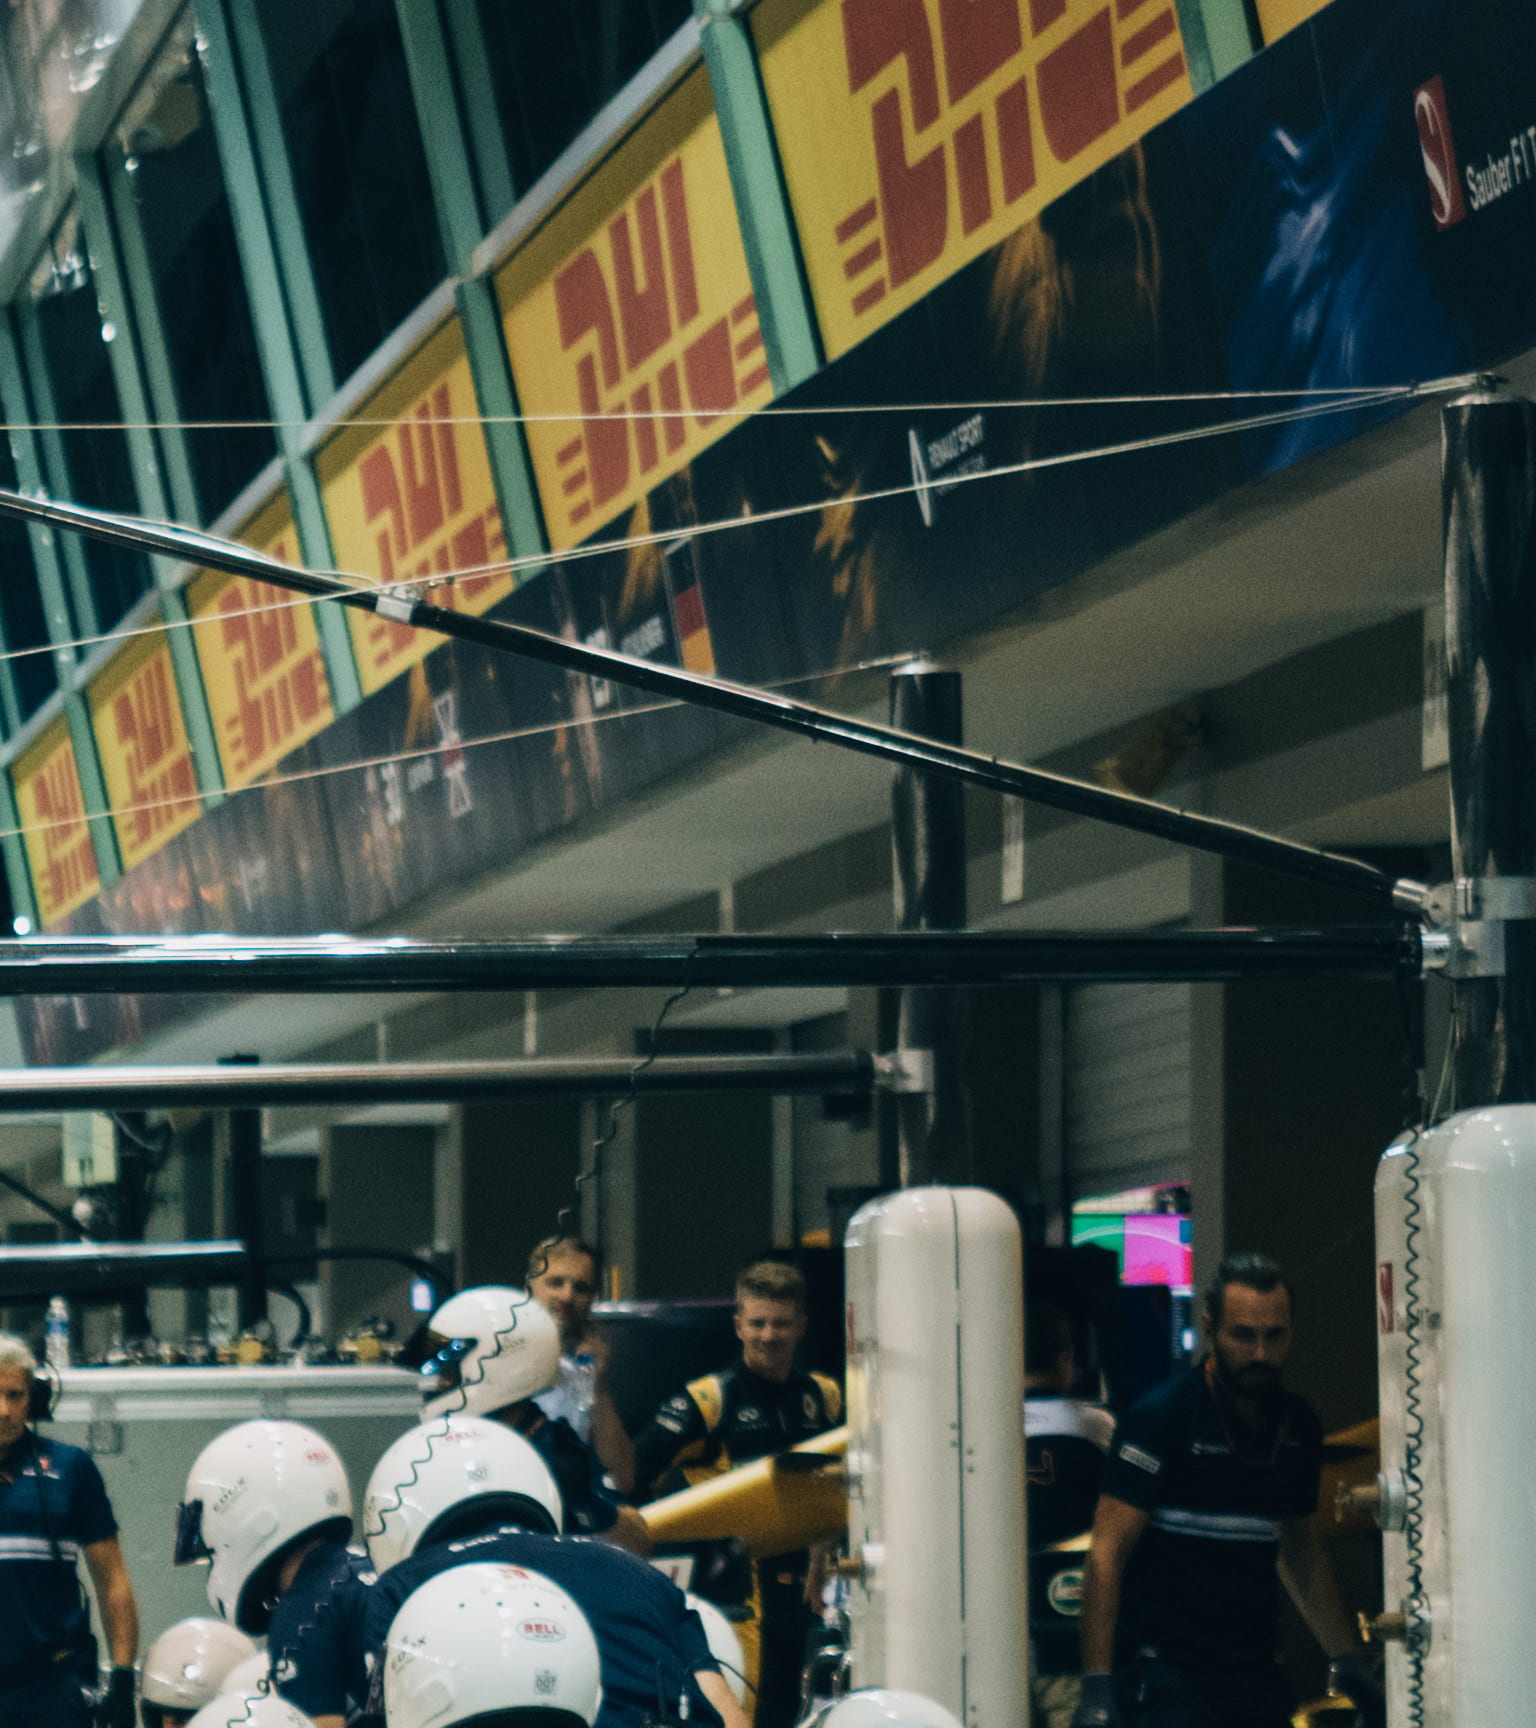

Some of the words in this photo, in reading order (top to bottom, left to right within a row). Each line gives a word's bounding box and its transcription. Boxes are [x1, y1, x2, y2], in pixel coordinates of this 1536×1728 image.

[1466, 152, 1511, 211] Sauber
[554, 157, 738, 509] DHL
[523, 1623, 561, 1635] BELL
